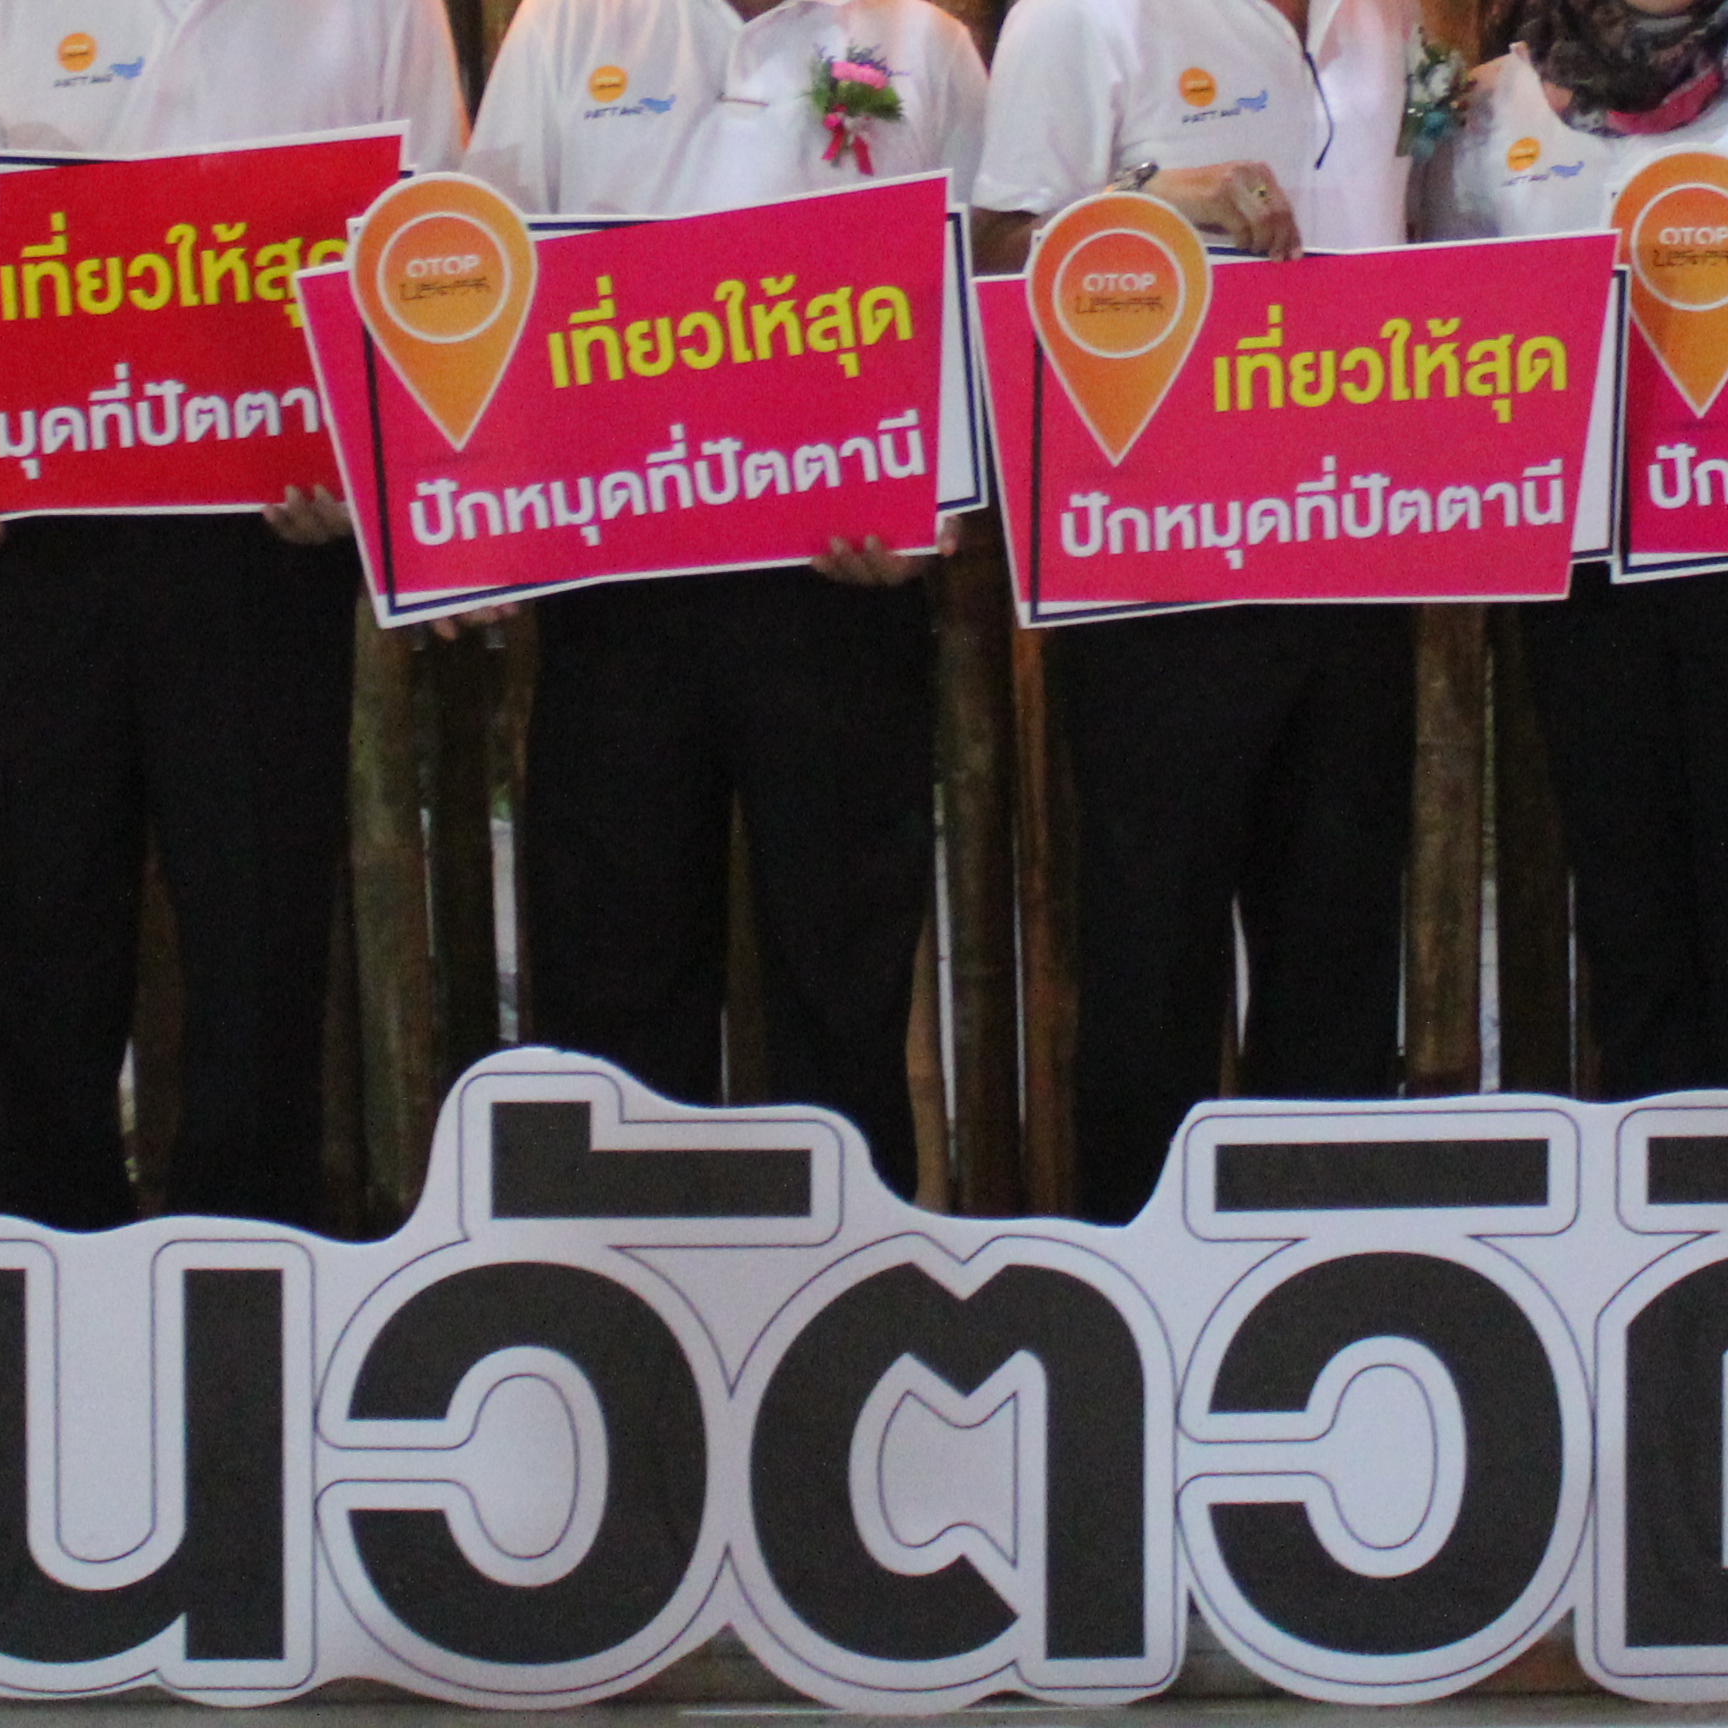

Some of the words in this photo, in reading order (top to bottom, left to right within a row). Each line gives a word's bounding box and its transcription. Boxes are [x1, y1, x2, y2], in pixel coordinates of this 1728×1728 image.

[405, 253, 481, 278] OTOP
[1082, 272, 1158, 293] OTOP
[547, 274, 914, 390] เที่ยวให้สุด
[1212, 304, 1568, 424] เที่ยวให้สุด
[408, 408, 927, 547] ปักหมุดที่ปัตตานี
[1059, 455, 1564, 571] ปักหมุดที่ปัตตานี
